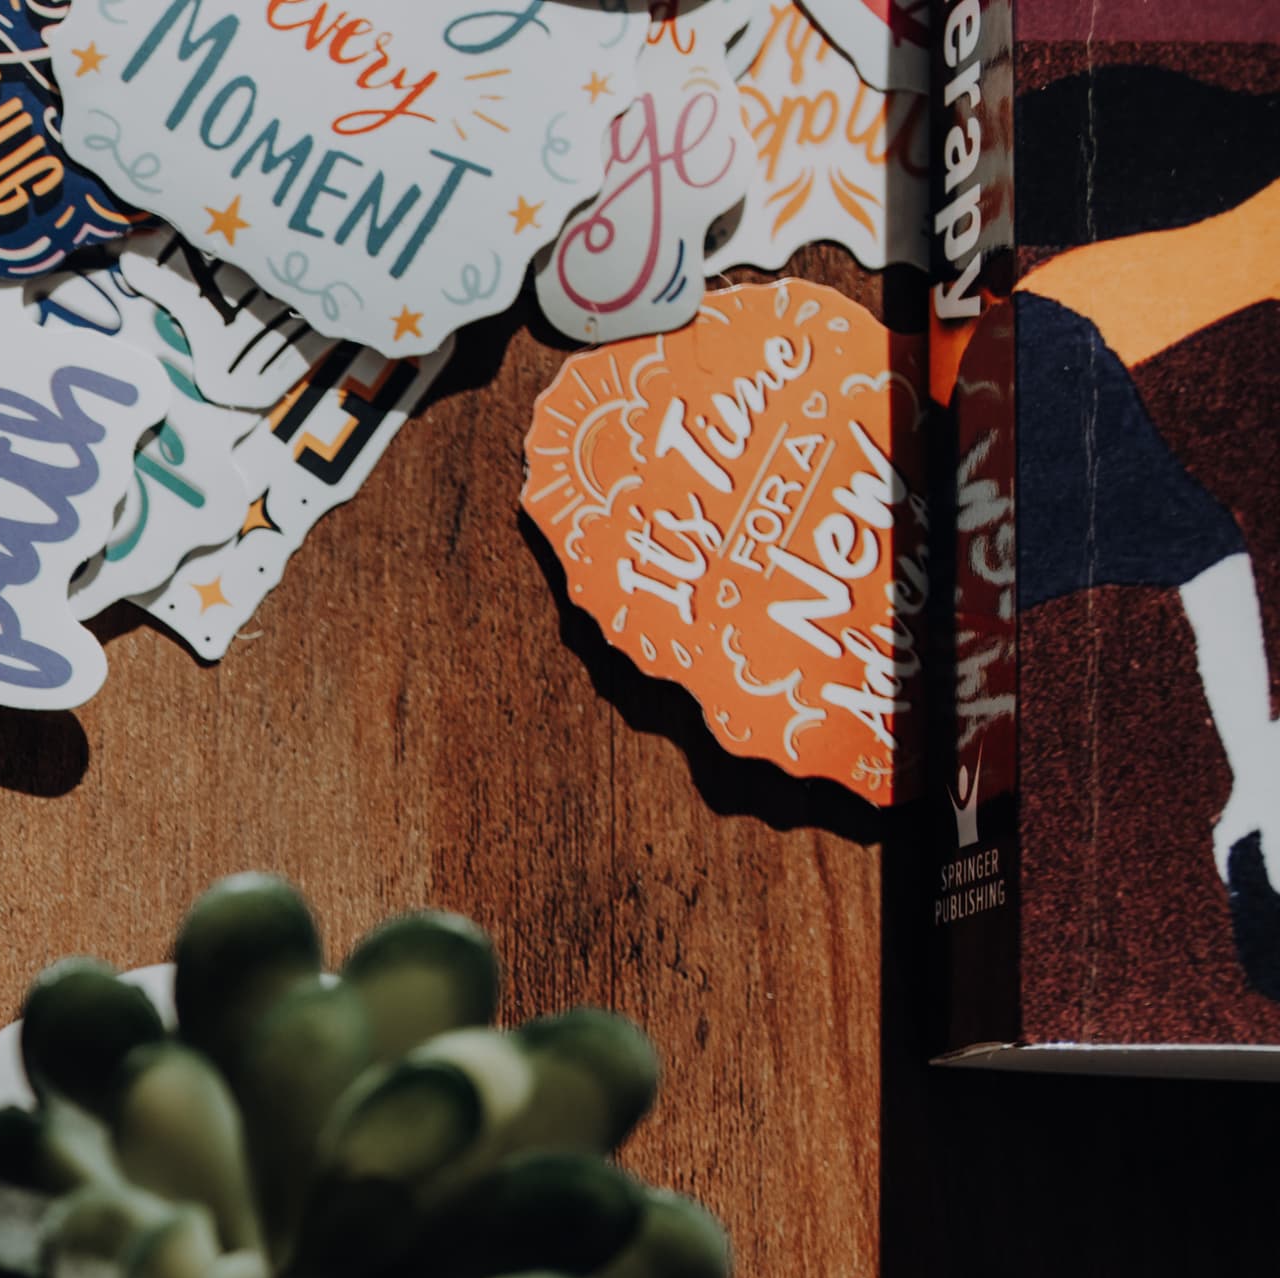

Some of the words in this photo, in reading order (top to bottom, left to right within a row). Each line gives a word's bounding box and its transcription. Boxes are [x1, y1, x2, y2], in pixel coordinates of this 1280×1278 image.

[265, 0, 439, 136] every
[738, 77, 931, 183] mak
[120, 0, 493, 280] MOMENT
[655, 334, 811, 493] Time
[616, 492, 724, 624] It's
[730, 474, 803, 573] FOR
[785, 432, 825, 472] A
[766, 419, 907, 660] New
[934, 879, 1006, 927] PUBLISHING
[940, 848, 1000, 891] SPRINGER
